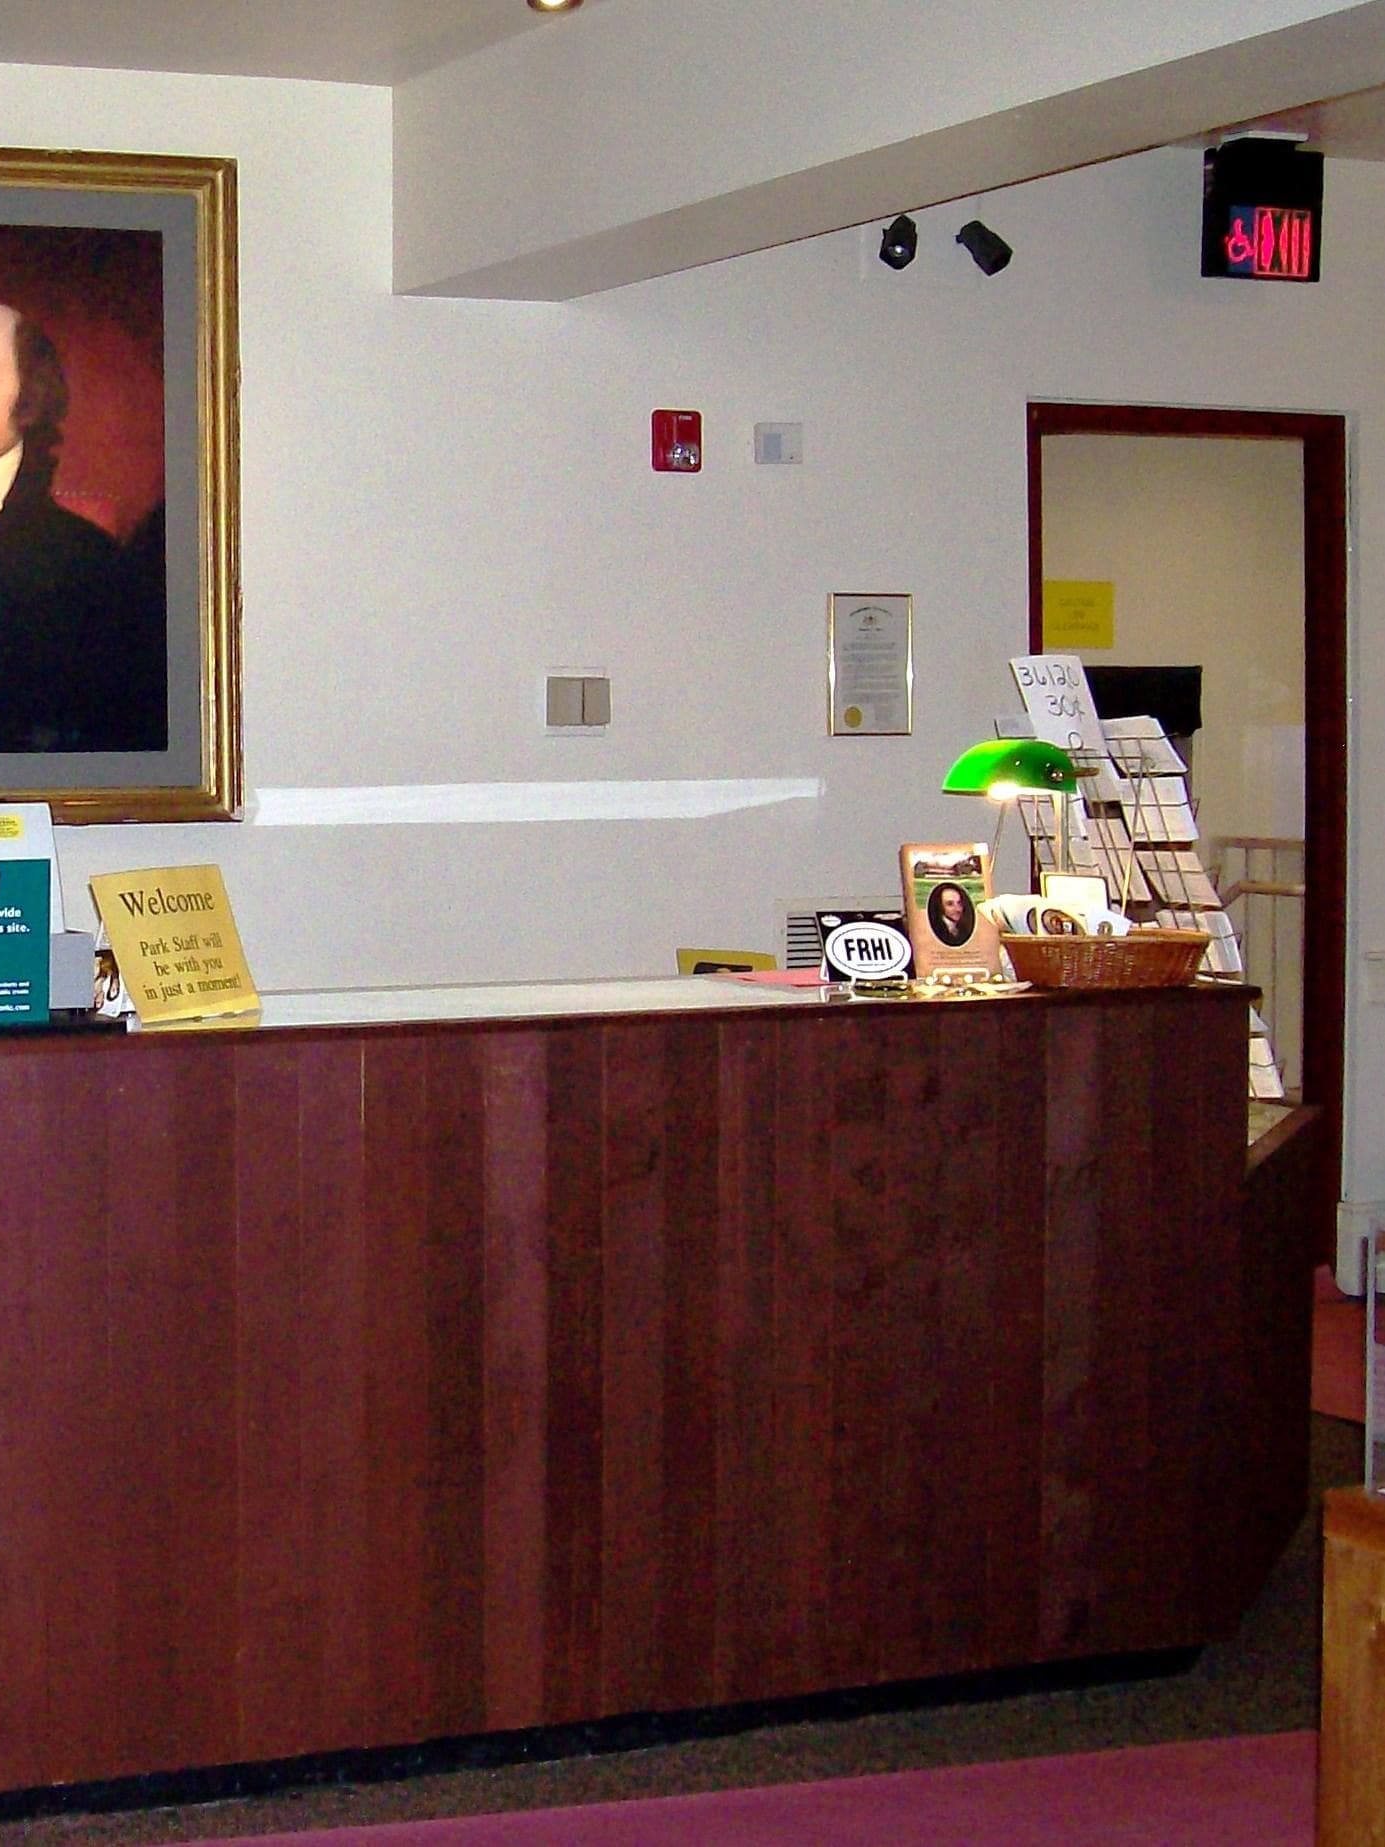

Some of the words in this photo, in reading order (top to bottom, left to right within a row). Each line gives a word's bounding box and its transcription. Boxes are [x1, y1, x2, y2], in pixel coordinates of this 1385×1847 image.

[119, 887, 215, 917] Welcome
[6, 922, 31, 934] site.
[139, 937, 171, 957] Park
[172, 933, 200, 952] Staff
[202, 931, 223, 948] will
[843, 937, 893, 962] FRHI
[153, 961, 170, 977] be
[174, 955, 201, 973] with
[202, 957, 223, 975] you
[142, 983, 158, 1000] in
[159, 981, 183, 1002] just
[186, 983, 195, 994] a
